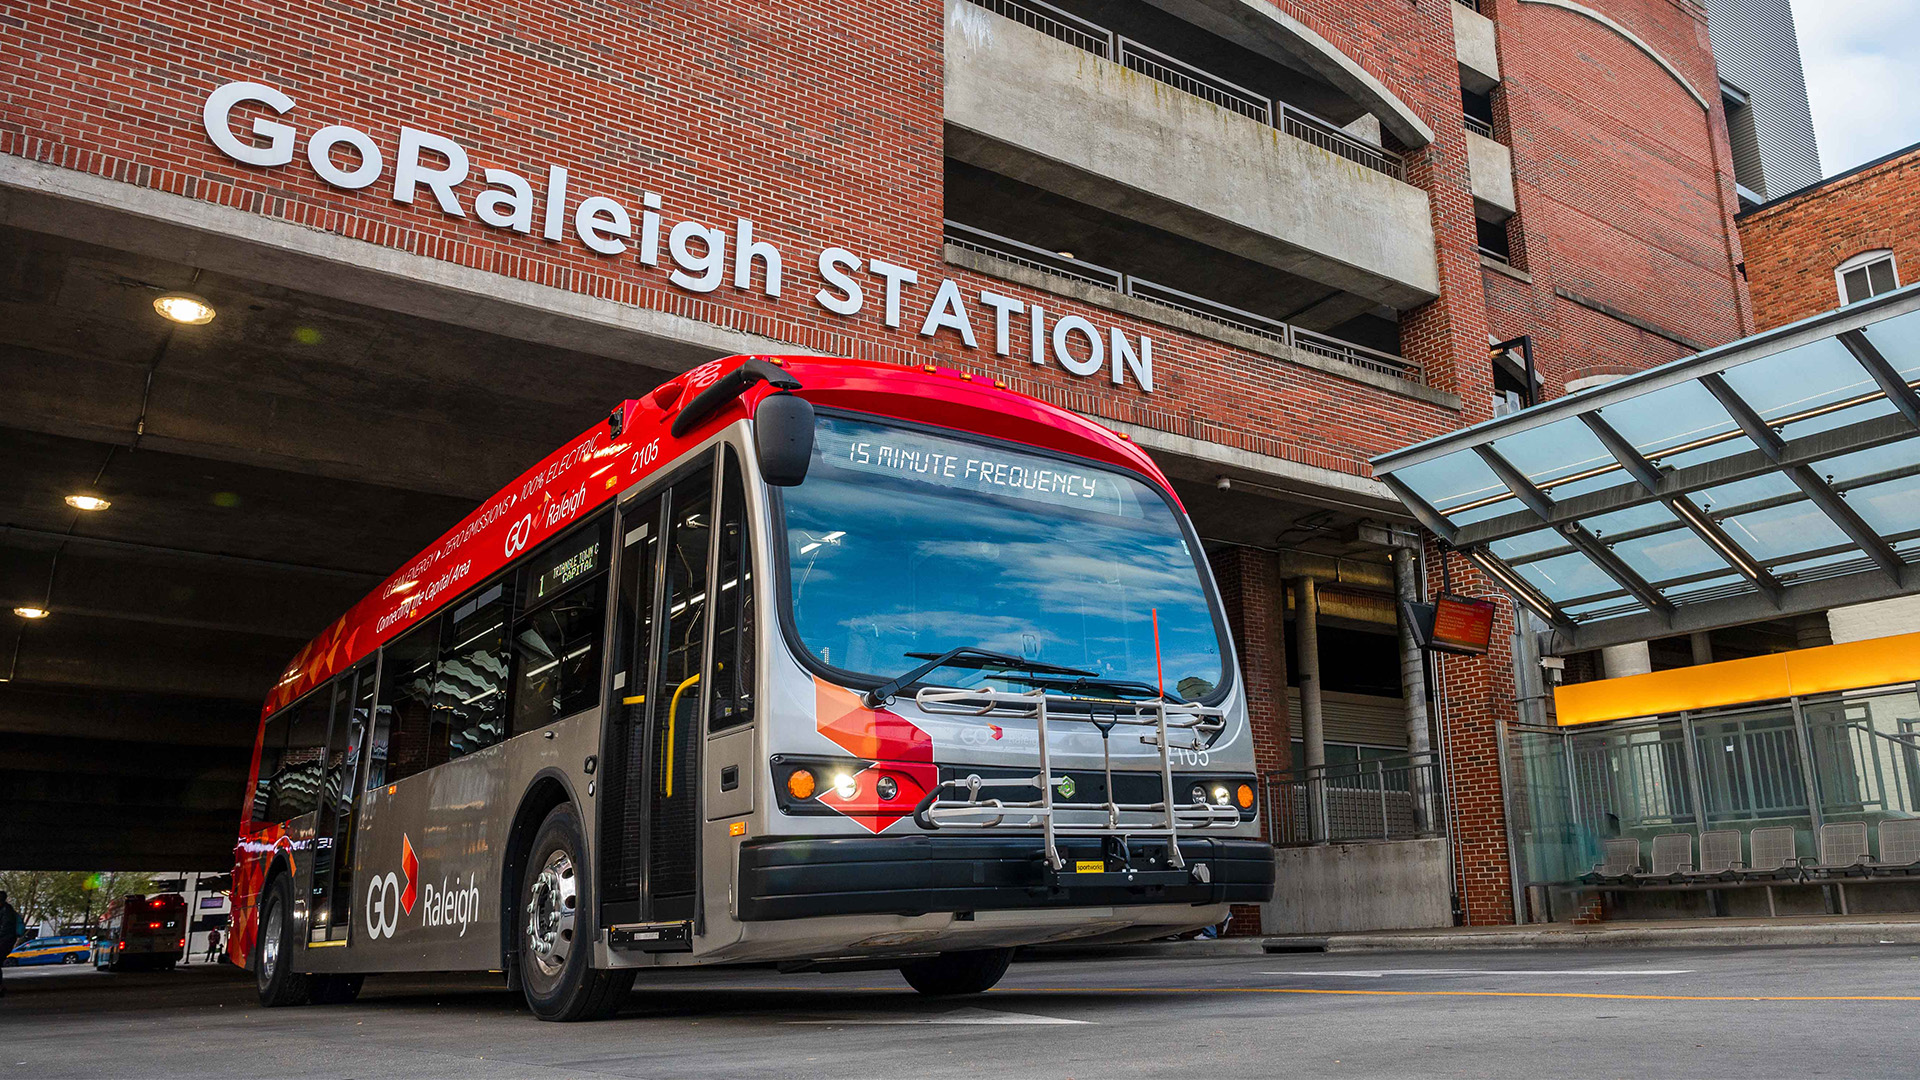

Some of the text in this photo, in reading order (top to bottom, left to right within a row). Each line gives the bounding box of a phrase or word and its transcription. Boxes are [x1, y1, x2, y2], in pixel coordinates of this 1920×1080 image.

[203, 81, 1154, 394] GoRaleigh STATION
[630, 437, 660, 475] 2105
[850, 442, 1097, 498] 15 MINUTE FREQUENCY
[441, 530, 465, 559] ZERO
[463, 495, 511, 543] EMISSIONS
[520, 469, 547, 502] 100%
[546, 431, 602, 484] ELECTRIC
[505, 481, 586, 558] GO Raleigh
[538, 575, 544, 597] 1
[553, 554, 578, 579] TRIANGLE
[562, 557, 593, 583] CAPITAL
[376, 559, 471, 634] Connecting the Capital Area
[820, 646, 830, 665] 1
[366, 871, 479, 940] GO Raleigh
